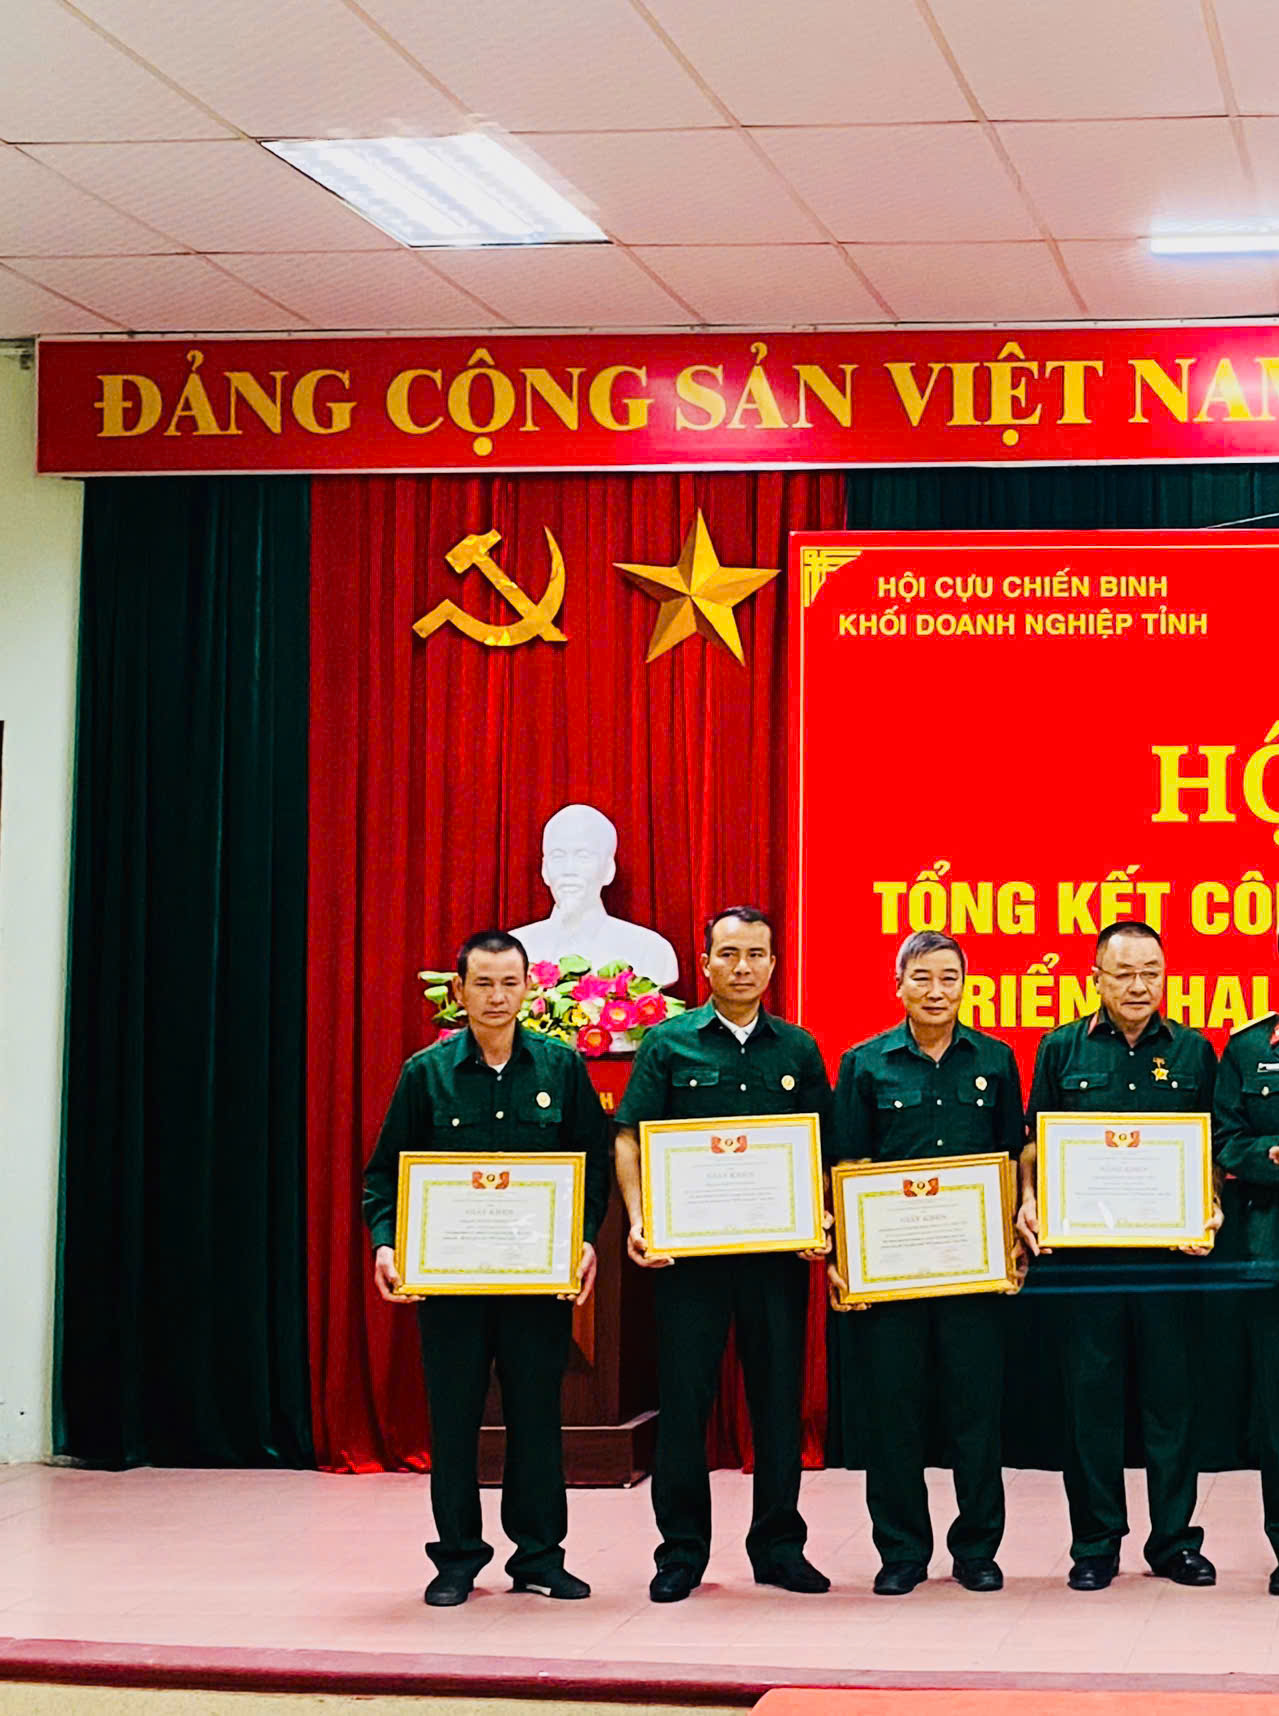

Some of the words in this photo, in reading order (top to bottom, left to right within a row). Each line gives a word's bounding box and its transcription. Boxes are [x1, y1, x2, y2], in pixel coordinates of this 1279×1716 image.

[94, 350, 358, 437] ĐẢNG
[386, 347, 652, 456] CỘNG
[674, 342, 857, 431] SẢN
[885, 341, 1103, 446] VIỆT
[838, 606, 906, 636] KHỐI
[916, 613, 1015, 636] DOANH
[1025, 608, 1133, 639] NGHIỆP
[1141, 605, 1208, 635] TỈNH
[878, 572, 925, 602] HỘI
[935, 574, 993, 602] CỰU
[1002, 568, 1089, 598] CHIẾN
[1099, 576, 1168, 598] BINH
[873, 860, 1035, 935] TỔNG
[1058, 864, 1171, 935] KẾT
[957, 952, 1101, 1028] RIỂN
[1167, 975, 1273, 1029] HAI
